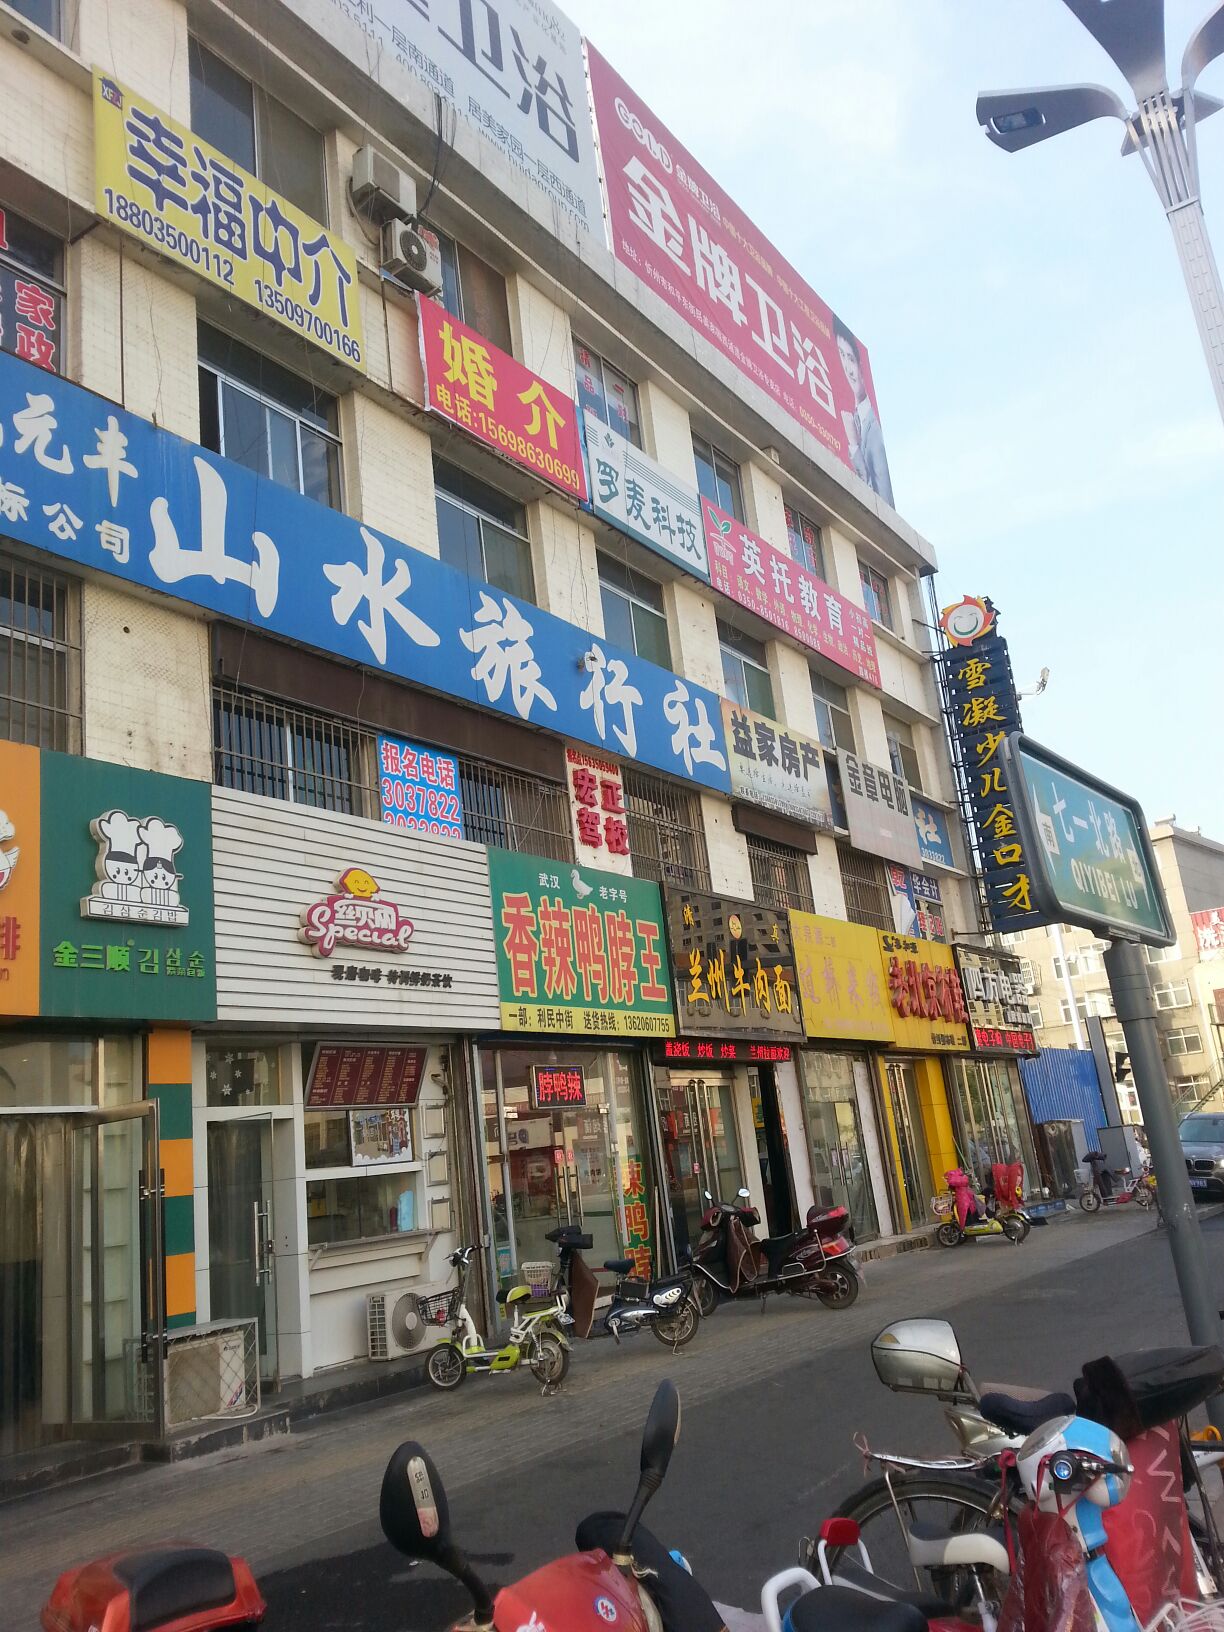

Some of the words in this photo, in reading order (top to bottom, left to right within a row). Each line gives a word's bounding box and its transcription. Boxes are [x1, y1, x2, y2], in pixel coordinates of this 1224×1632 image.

[614, 97, 673, 174] GOLD
[126, 106, 352, 328] 幸福中介
[104, 188, 236, 286] 18803500112
[254, 279, 362, 364] 13509700166
[622, 155, 837, 419] 金牌卫浴
[15, 280, 56, 373] 家政
[438, 320, 566, 450] 婚介
[0, 391, 139, 508] 元丰
[596, 457, 702, 560] 罗麦科技
[149, 455, 727, 777] 山水旅行社
[739, 533, 844, 636] 英托教育
[381, 741, 455, 791] 报名电话
[732, 710, 820, 782] 益家房产
[382, 777, 460, 823] 3037822
[572, 768, 626, 814] 宏正
[846, 754, 908, 817] 金章电脑
[577, 807, 630, 855] 驾校
[915, 808, 942, 846] 社
[1042, 822, 1056, 849] 南
[1051, 782, 1126, 864] 七一北路
[538, 873, 560, 890] 武汉
[599, 886, 628, 903] 老字号
[1070, 858, 1121, 903] QIYIBEI
[1119, 877, 1138, 910] LU
[308, 905, 412, 949] Special
[682, 903, 695, 926] 清
[502, 892, 668, 1006] 香辣鸭脖王
[688, 948, 792, 1016] 兰州牛肉面
[962, 966, 1028, 1006] 四方电器
[665, 1041, 691, 1058] 盖浇饭
[697, 1042, 714, 1059] 炒饭
[720, 1043, 737, 1059] 炒菜
[538, 1071, 582, 1102] 脖鸭辣
